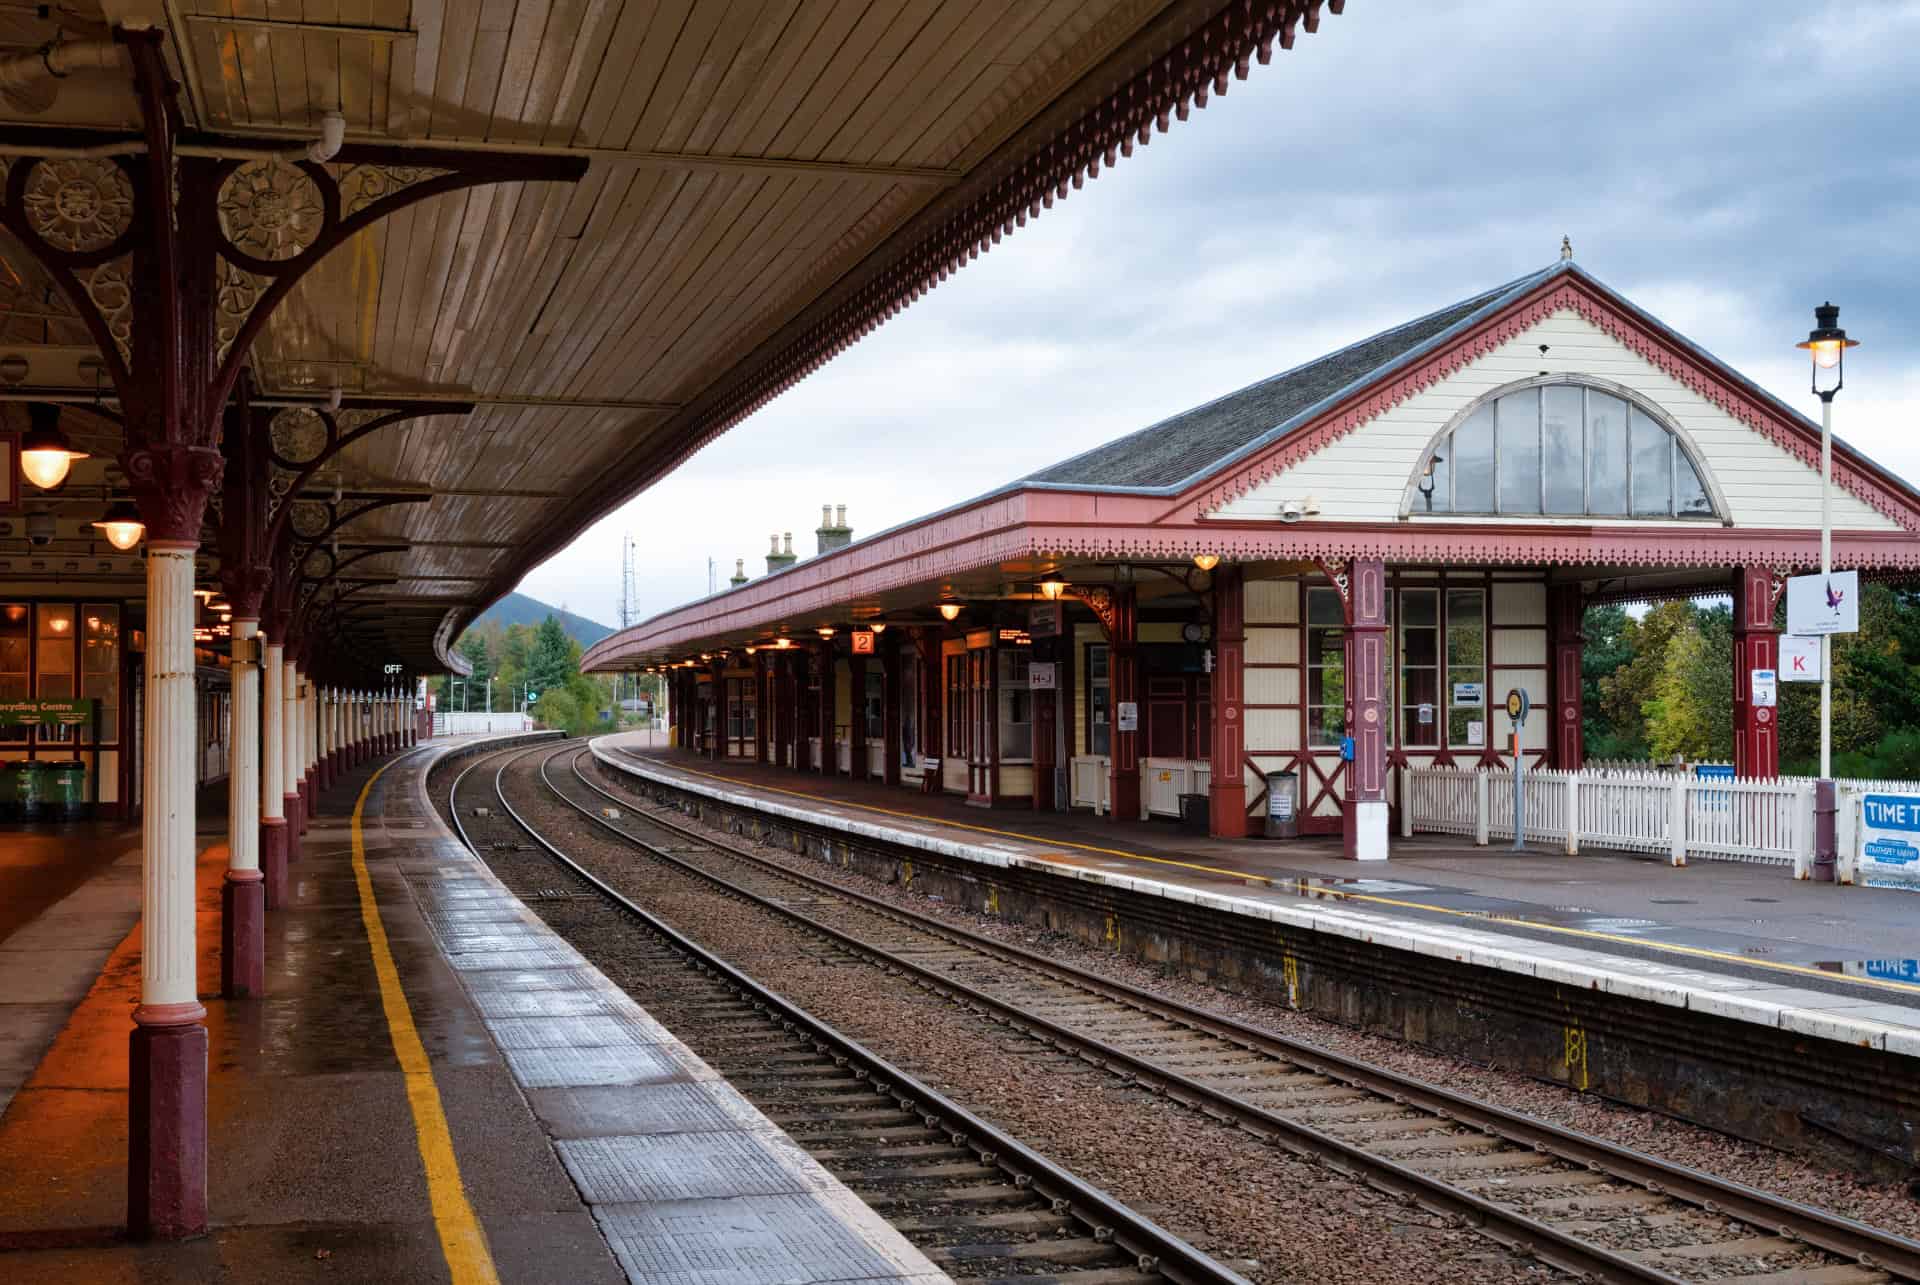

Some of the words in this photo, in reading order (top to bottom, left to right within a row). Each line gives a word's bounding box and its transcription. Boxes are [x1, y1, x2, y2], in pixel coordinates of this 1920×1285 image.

[858, 636, 868, 650] 2
[384, 664, 403, 674] OFF
[1793, 655, 1806, 672] K
[40, 702, 73, 711] Centre
[1866, 801, 1906, 825] TIME
